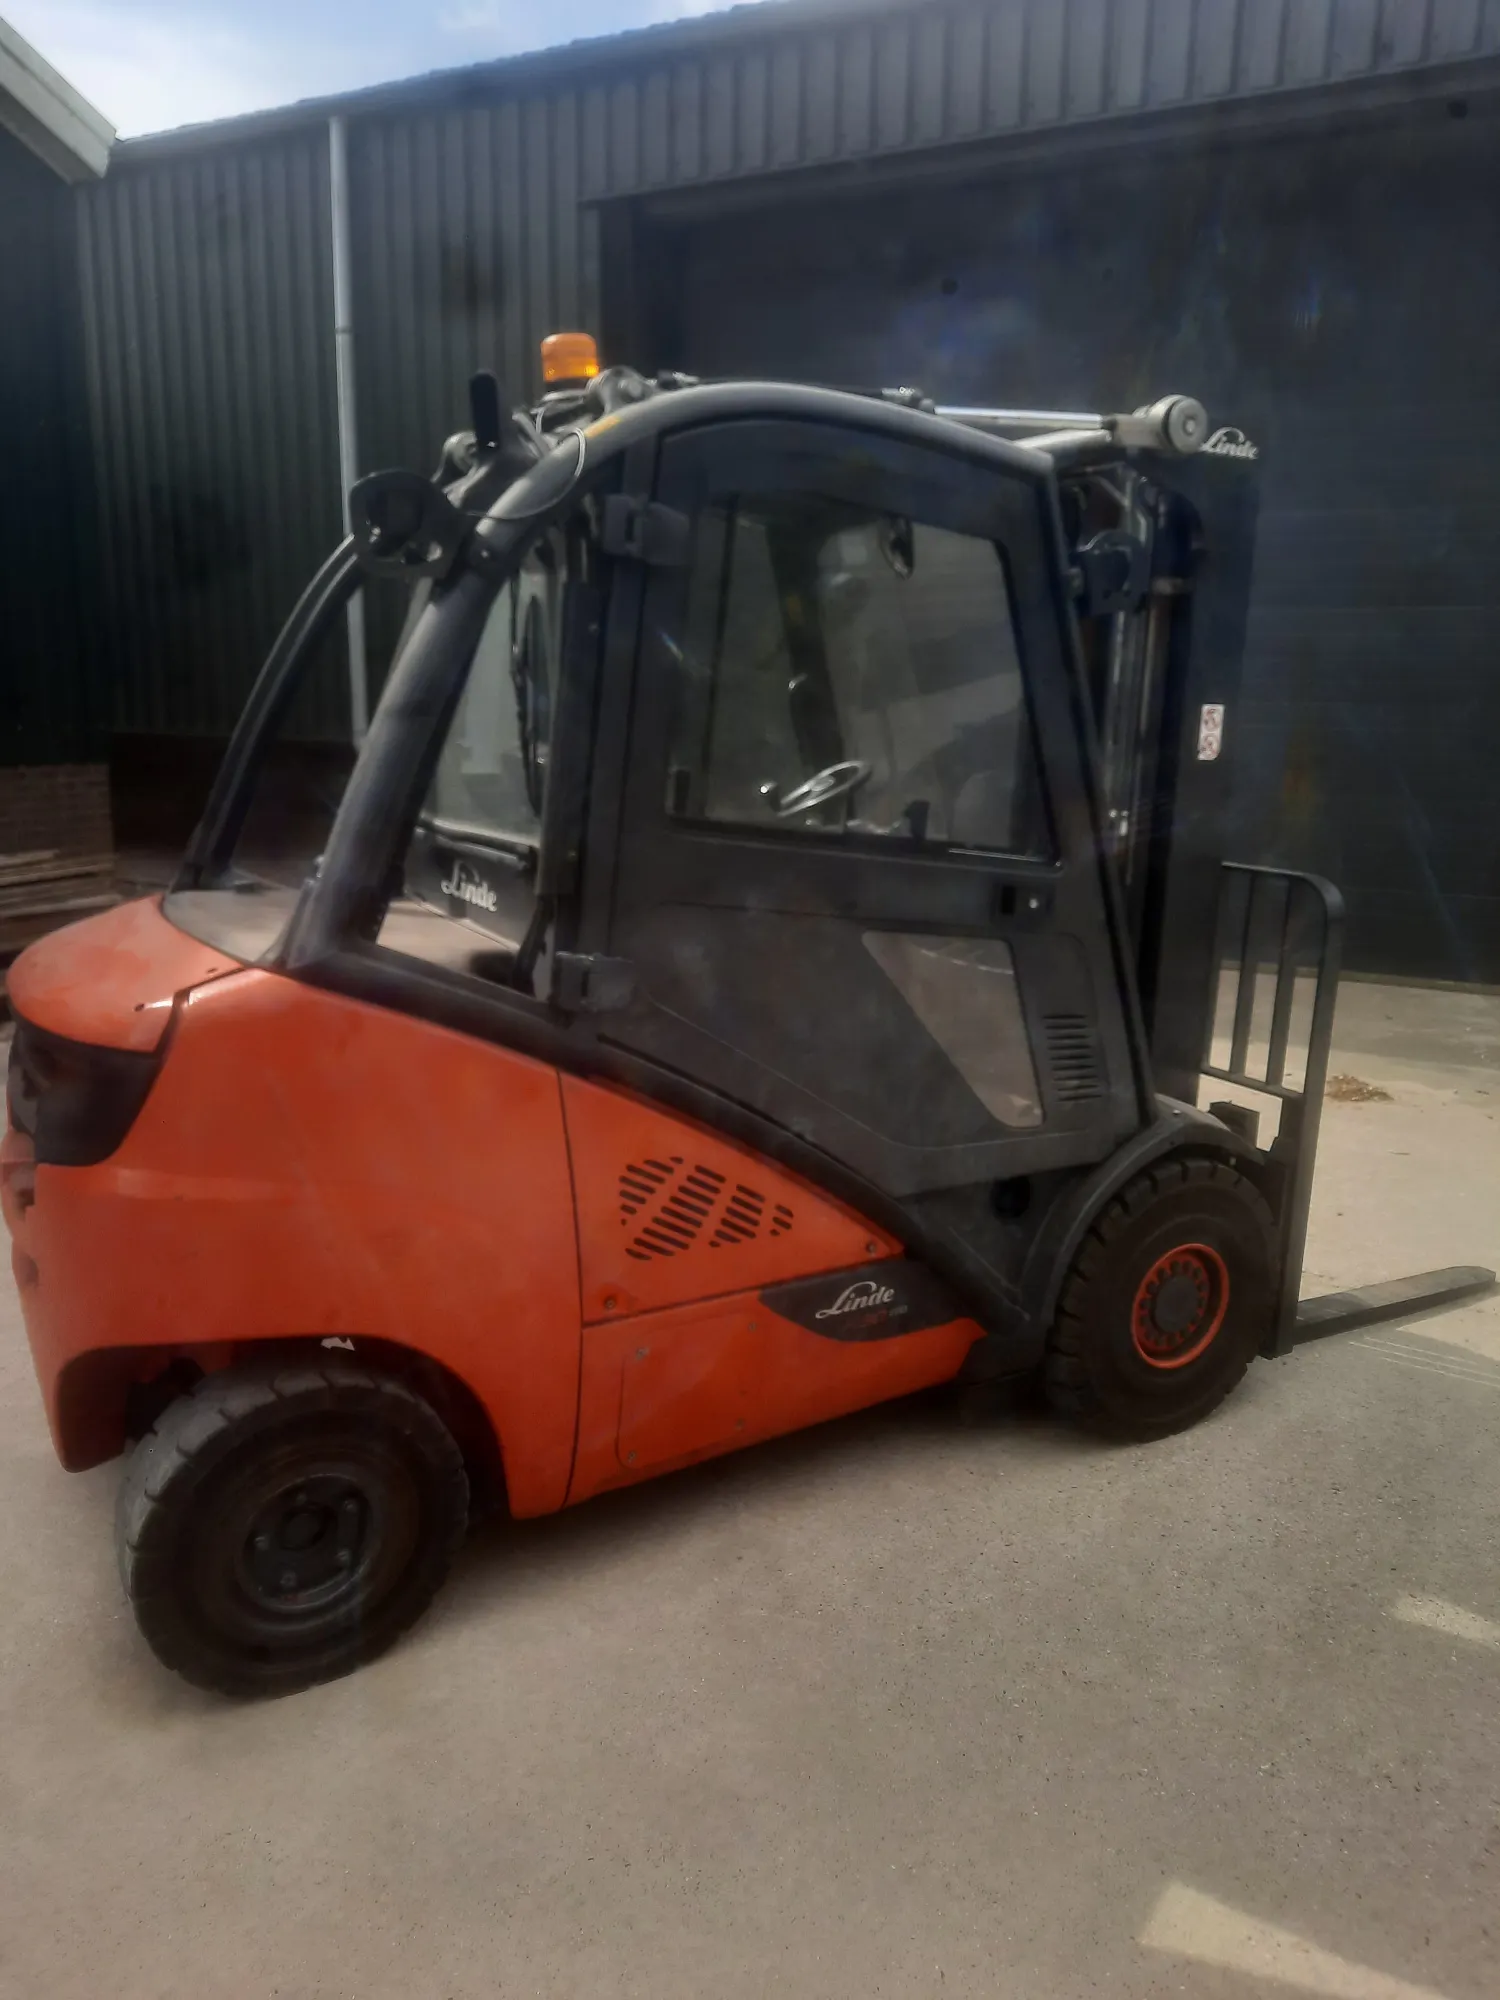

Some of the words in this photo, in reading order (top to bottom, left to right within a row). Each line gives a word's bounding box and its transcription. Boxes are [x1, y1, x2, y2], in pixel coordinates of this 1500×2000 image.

[1200, 426, 1259, 460] Linde
[441, 860, 498, 912] Linde
[815, 1280, 896, 1319] Linde
